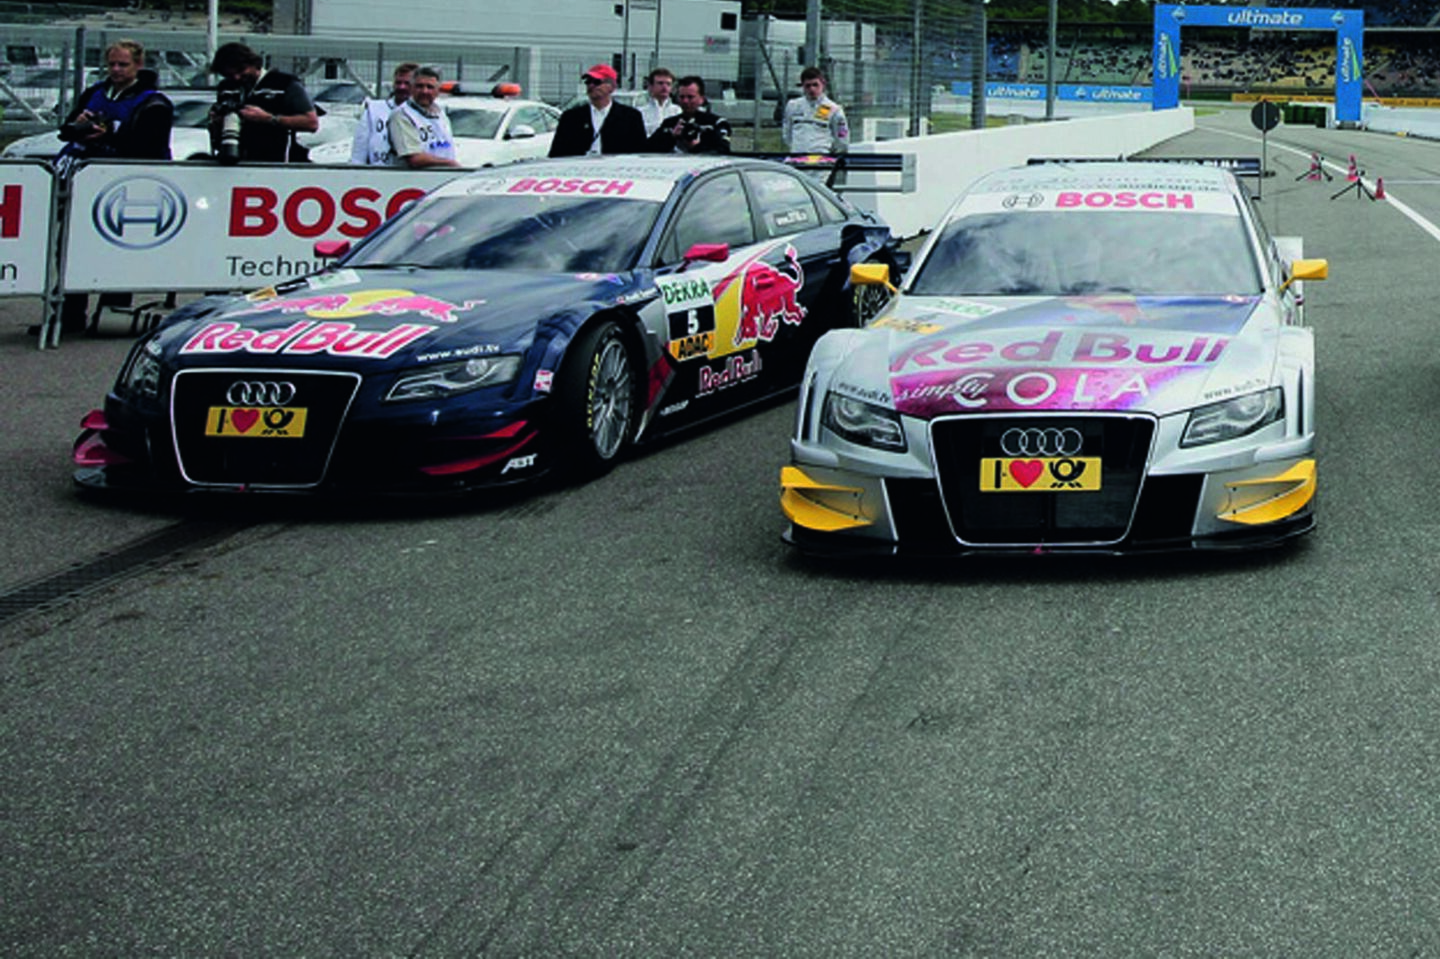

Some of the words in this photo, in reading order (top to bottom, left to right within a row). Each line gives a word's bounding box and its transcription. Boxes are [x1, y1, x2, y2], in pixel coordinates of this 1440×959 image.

[1227, 9, 1303, 26] ultimate
[987, 84, 1041, 98] ultimate
[1091, 87, 1143, 101] ultimate
[507, 177, 635, 195] BOSCH
[228, 186, 427, 238] BOSC
[1056, 192, 1195, 209] BOSCH
[661, 278, 710, 305] DEKRA
[686, 309, 699, 335] 5
[181, 321, 312, 354] Red
[285, 322, 436, 358] Bull
[416, 343, 500, 362] www.audi.tv
[889, 331, 1064, 372] Red
[1072, 332, 1229, 364] Bull
[896, 376, 990, 401] simply
[953, 372, 1149, 408] COLA
[501, 452, 539, 474] ABT
